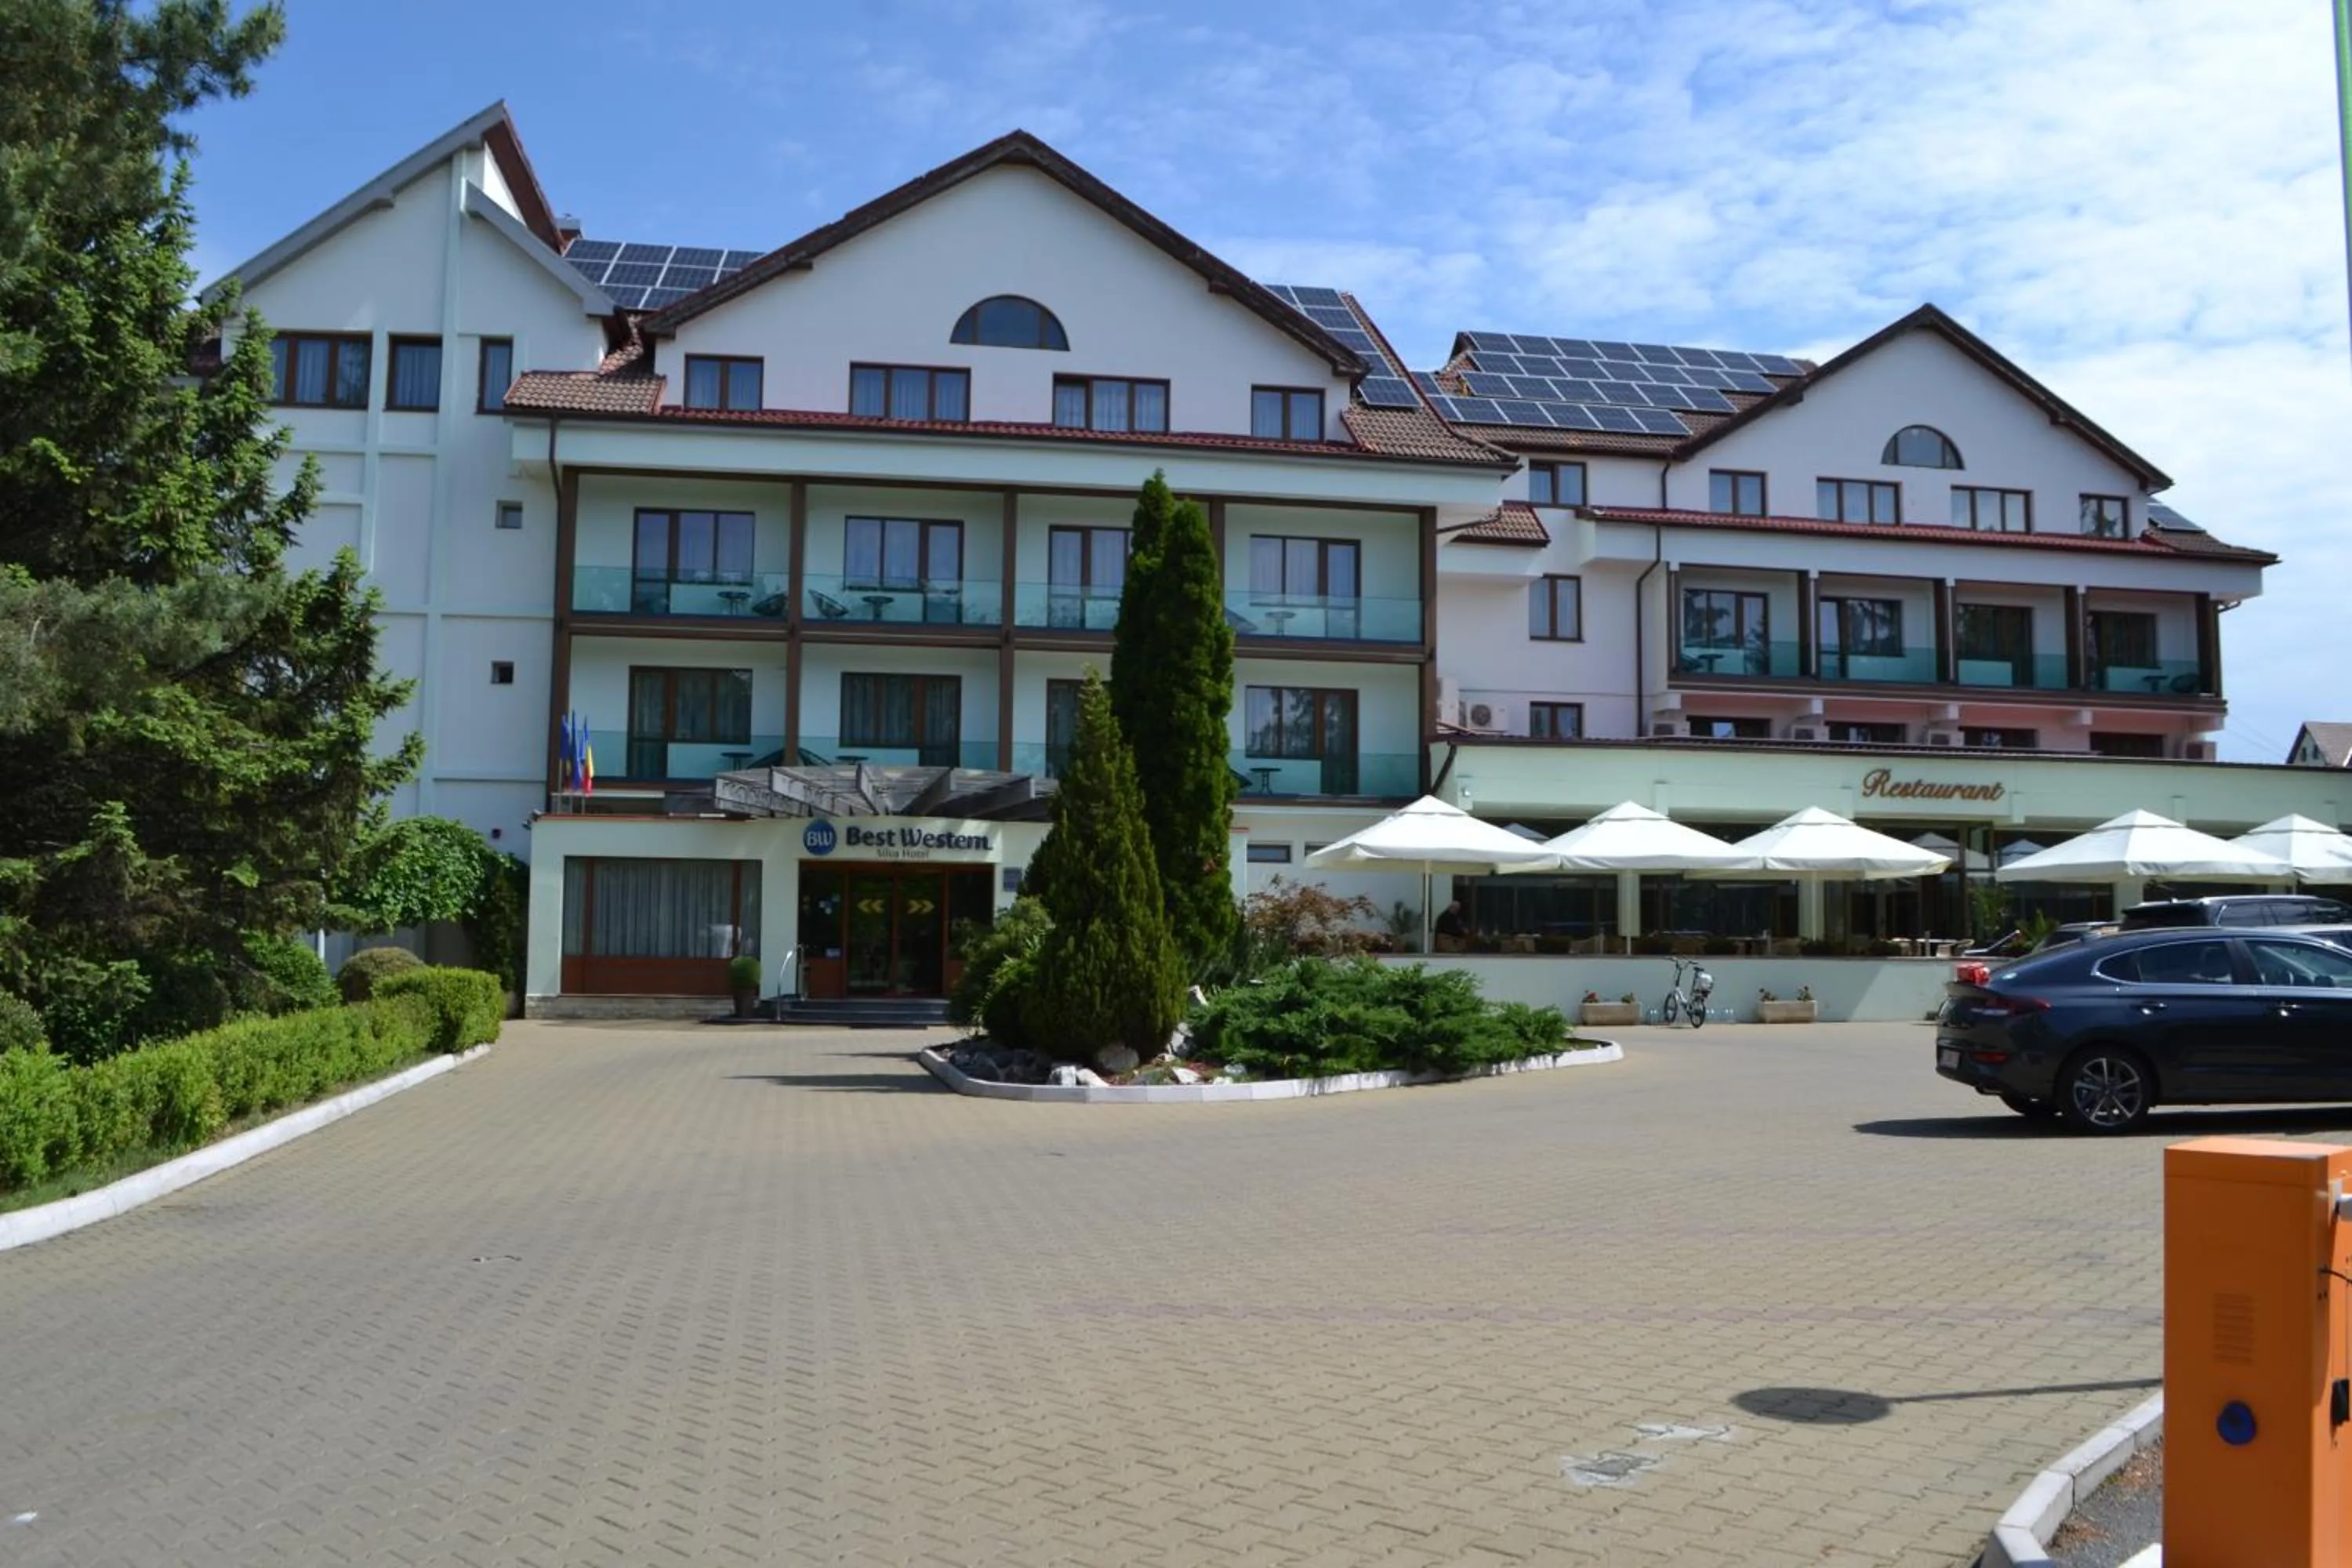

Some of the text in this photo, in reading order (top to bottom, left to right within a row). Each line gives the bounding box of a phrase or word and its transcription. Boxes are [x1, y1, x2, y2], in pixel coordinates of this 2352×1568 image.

[1861, 768, 2005, 801] Restaurant
[807, 831, 833, 847] BW
[845, 826, 896, 848] Best
